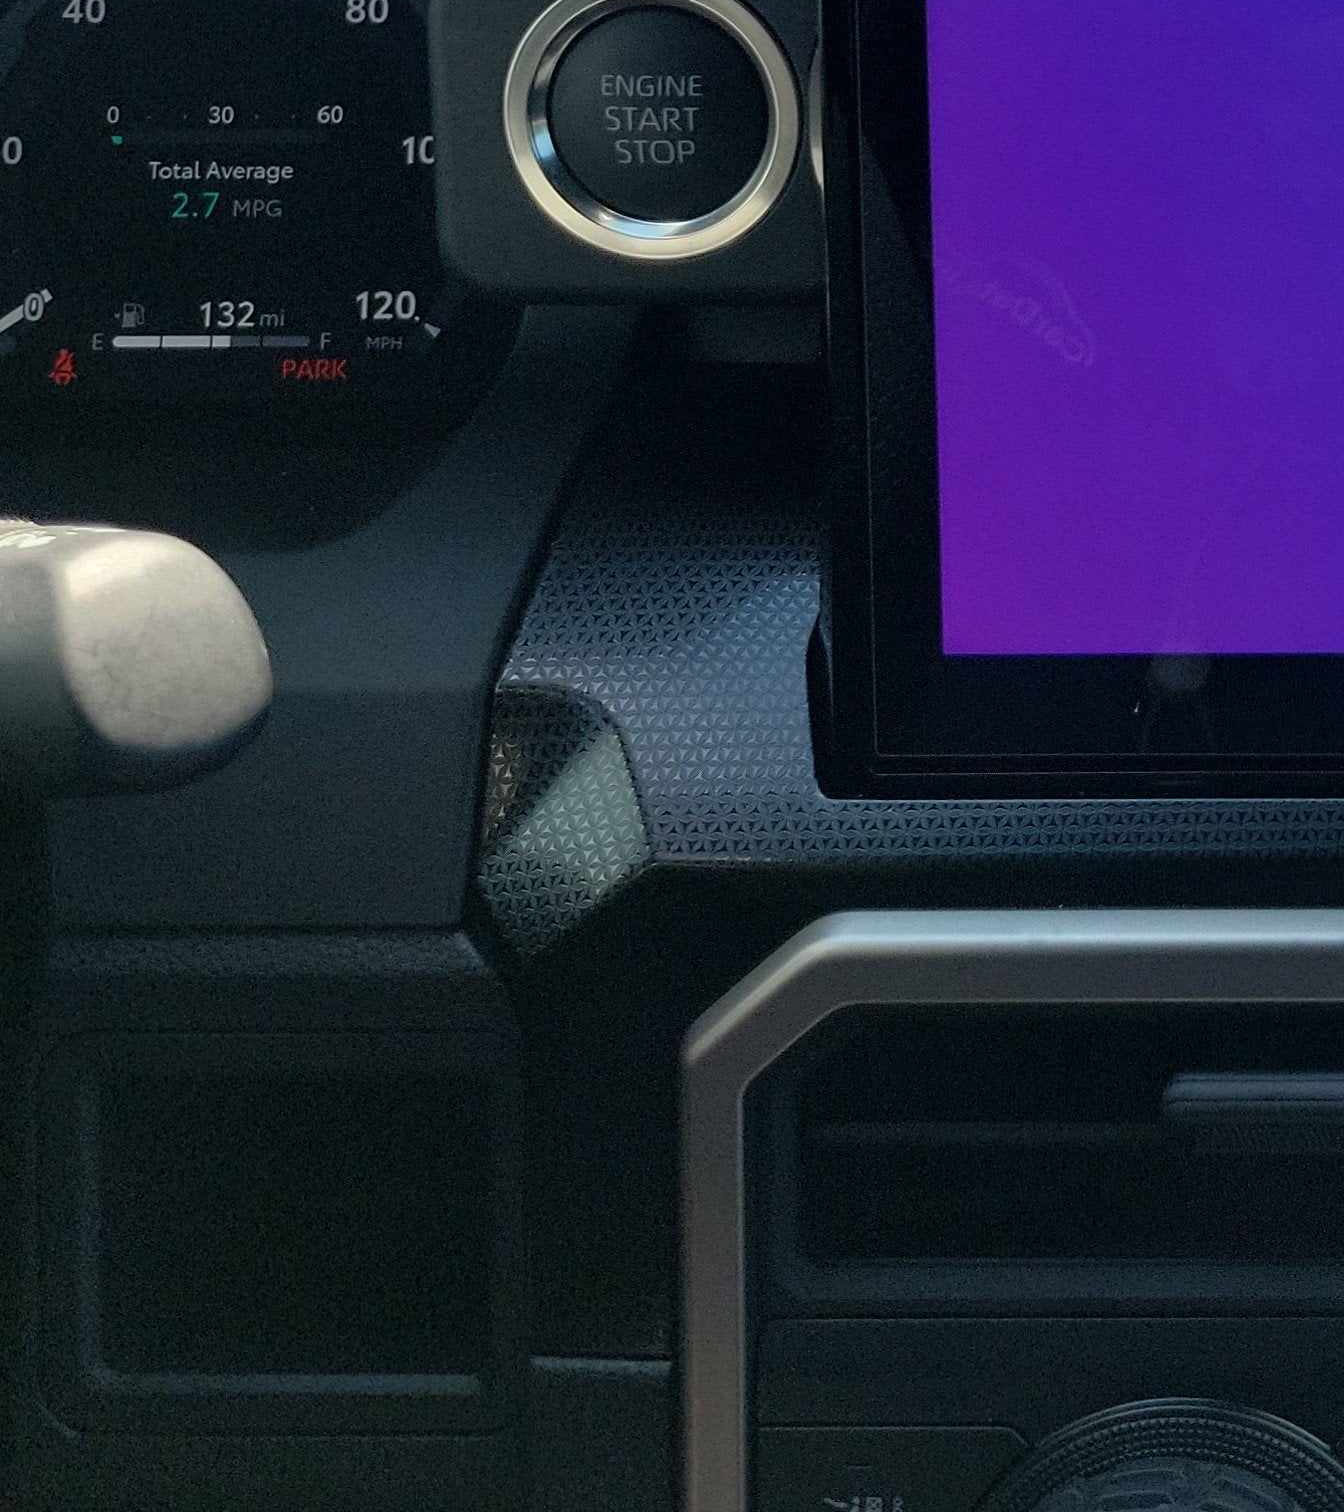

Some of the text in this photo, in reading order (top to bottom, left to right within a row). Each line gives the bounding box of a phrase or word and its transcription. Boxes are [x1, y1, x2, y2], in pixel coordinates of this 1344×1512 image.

[601, 73, 704, 97] ENGINE
[106, 105, 344, 124] 0 30 60
[605, 106, 700, 132] START
[614, 139, 696, 165] STOP
[148, 160, 294, 184] Total Average
[171, 191, 283, 219] 2.7 MPG
[24, 292, 45, 322] 0
[199, 300, 286, 328] 132 mi
[355, 290, 417, 321] 120
[91, 333, 104, 351] E
[320, 332, 333, 350] F
[366, 335, 403, 351] MPH
[281, 358, 347, 380] PARK
